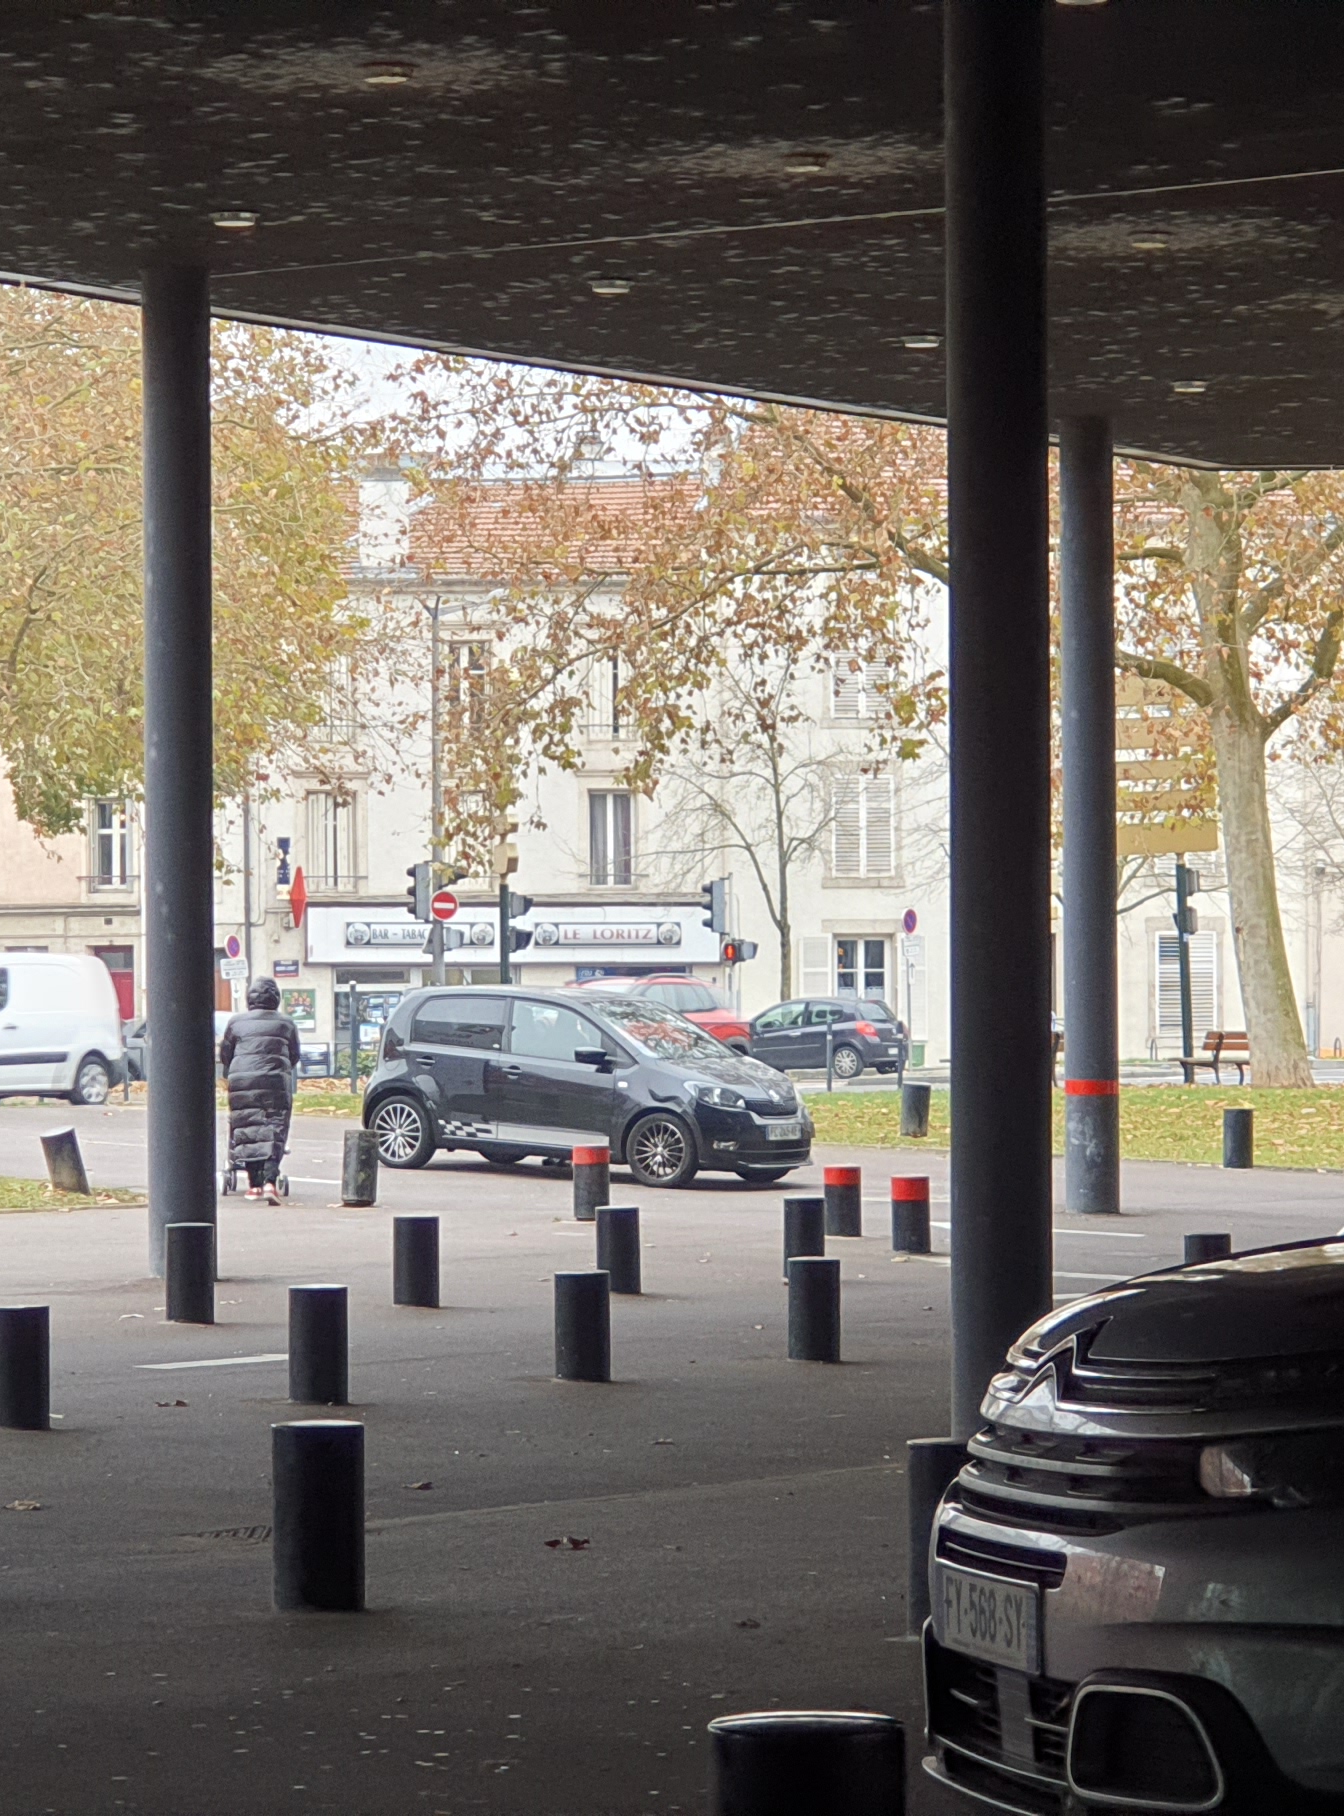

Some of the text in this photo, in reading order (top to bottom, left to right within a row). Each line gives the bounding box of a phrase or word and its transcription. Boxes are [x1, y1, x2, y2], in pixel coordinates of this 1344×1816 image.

[372, 928, 389, 940] BAR
[563, 928, 654, 940] LE LORITZ
